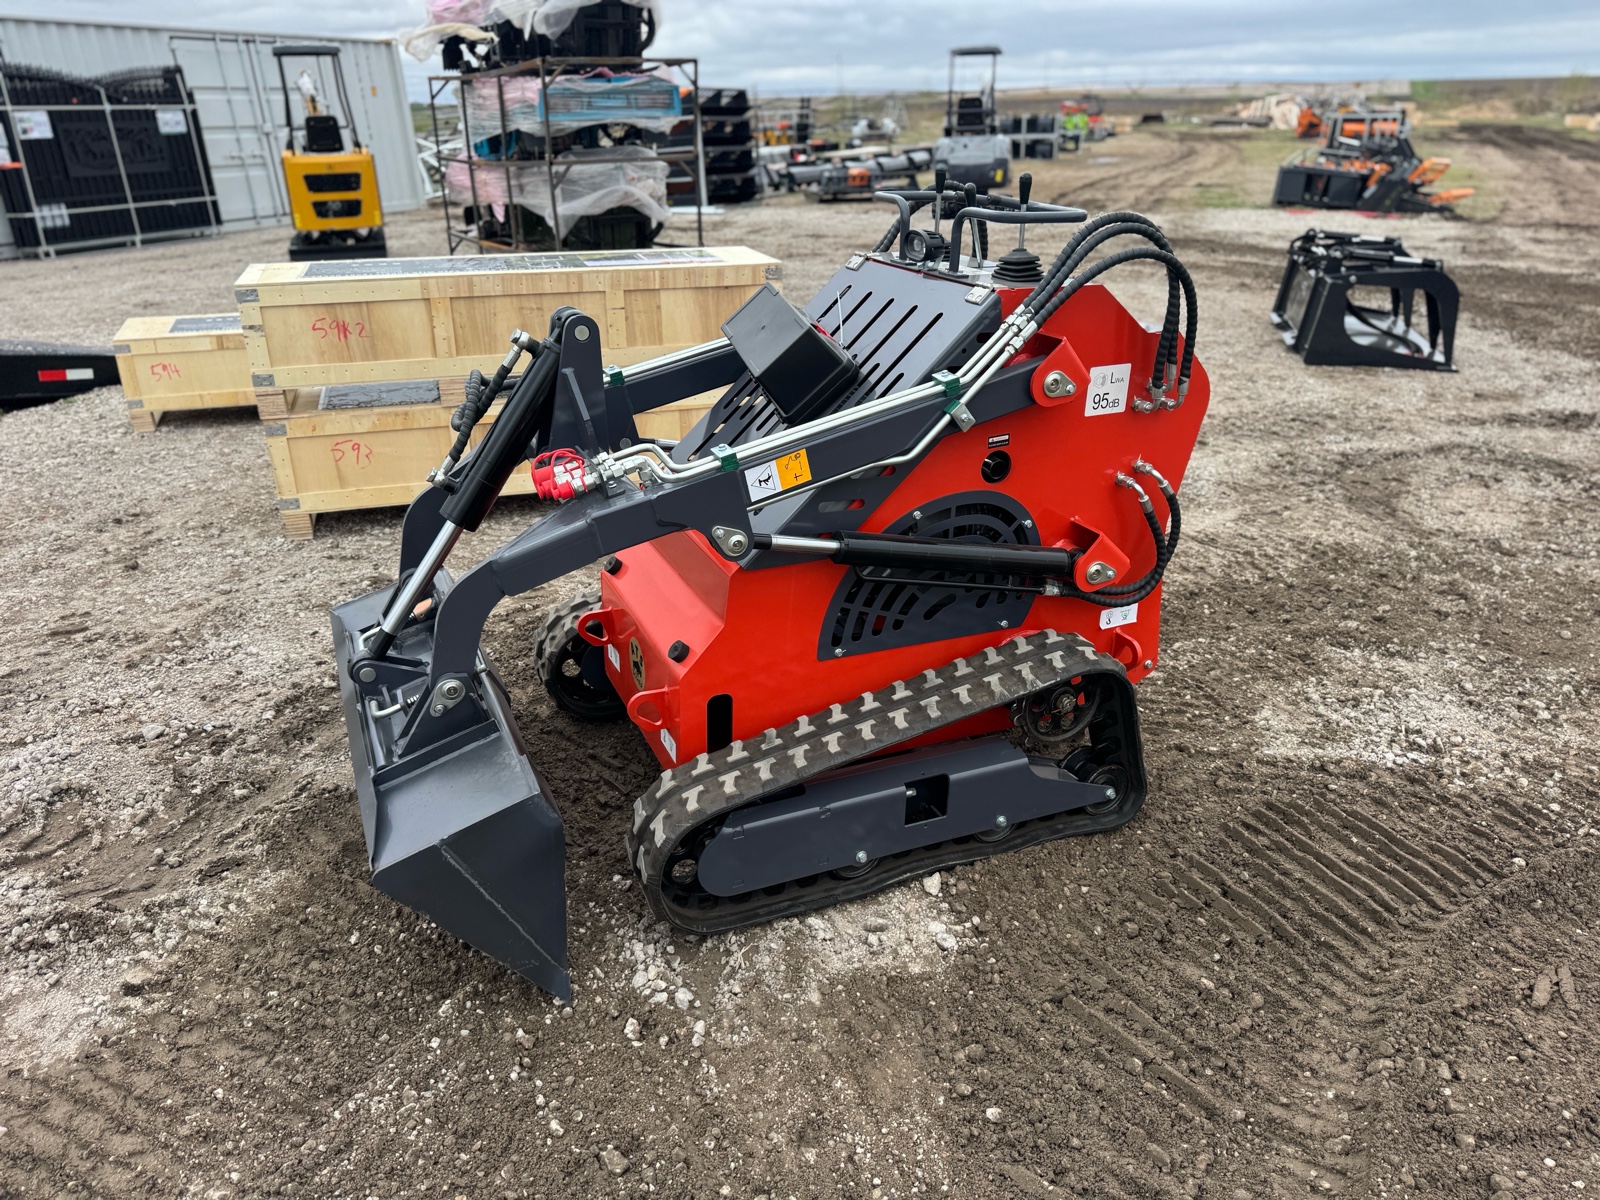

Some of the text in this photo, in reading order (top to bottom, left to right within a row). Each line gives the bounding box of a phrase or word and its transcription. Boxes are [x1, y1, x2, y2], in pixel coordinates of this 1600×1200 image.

[150, 362, 182, 382] 594
[1092, 392, 1120, 410] 95dB
[330, 439, 373, 470] 593
